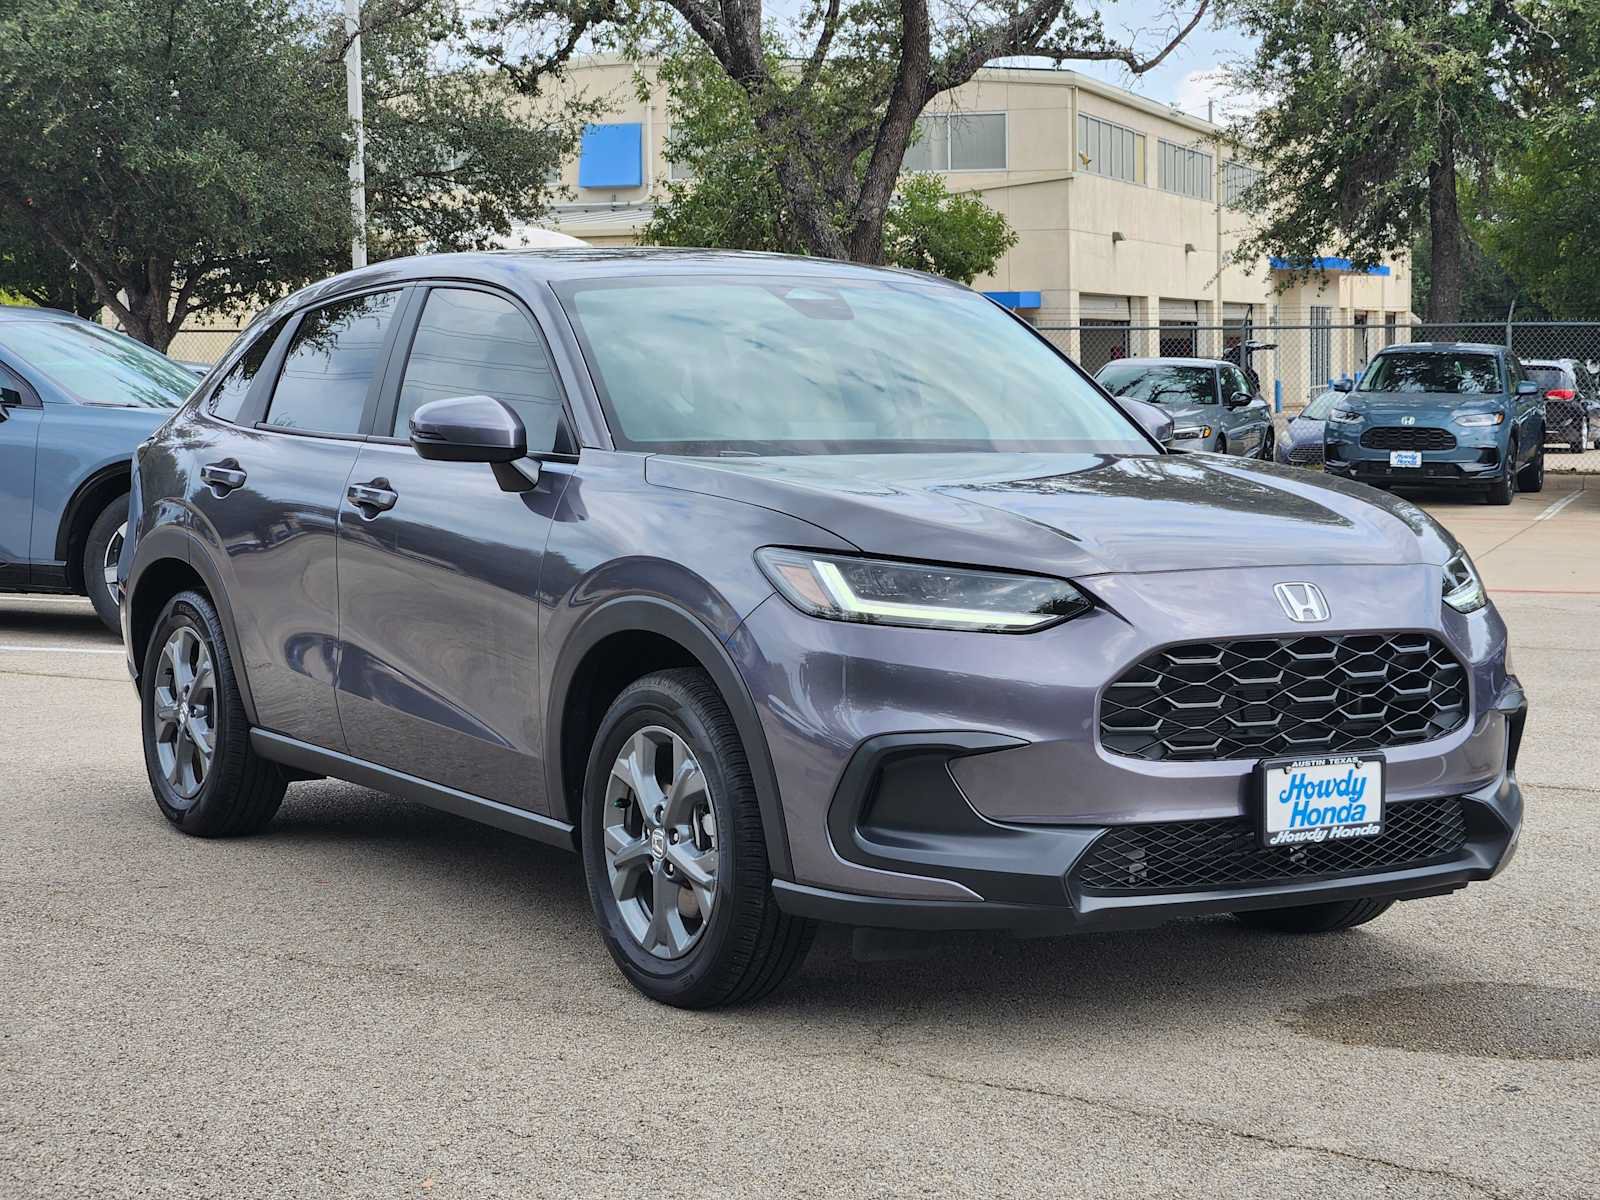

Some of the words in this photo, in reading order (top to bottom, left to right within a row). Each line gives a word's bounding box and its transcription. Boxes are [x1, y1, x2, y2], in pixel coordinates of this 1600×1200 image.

[1291, 759, 1326, 768] AUSTIN
[1329, 756, 1359, 765] TEXAS
[1280, 769, 1367, 803] Howdy
[1290, 800, 1366, 828] Honda
[1270, 827, 1328, 844] Howdy
[1329, 824, 1380, 838] Honda
